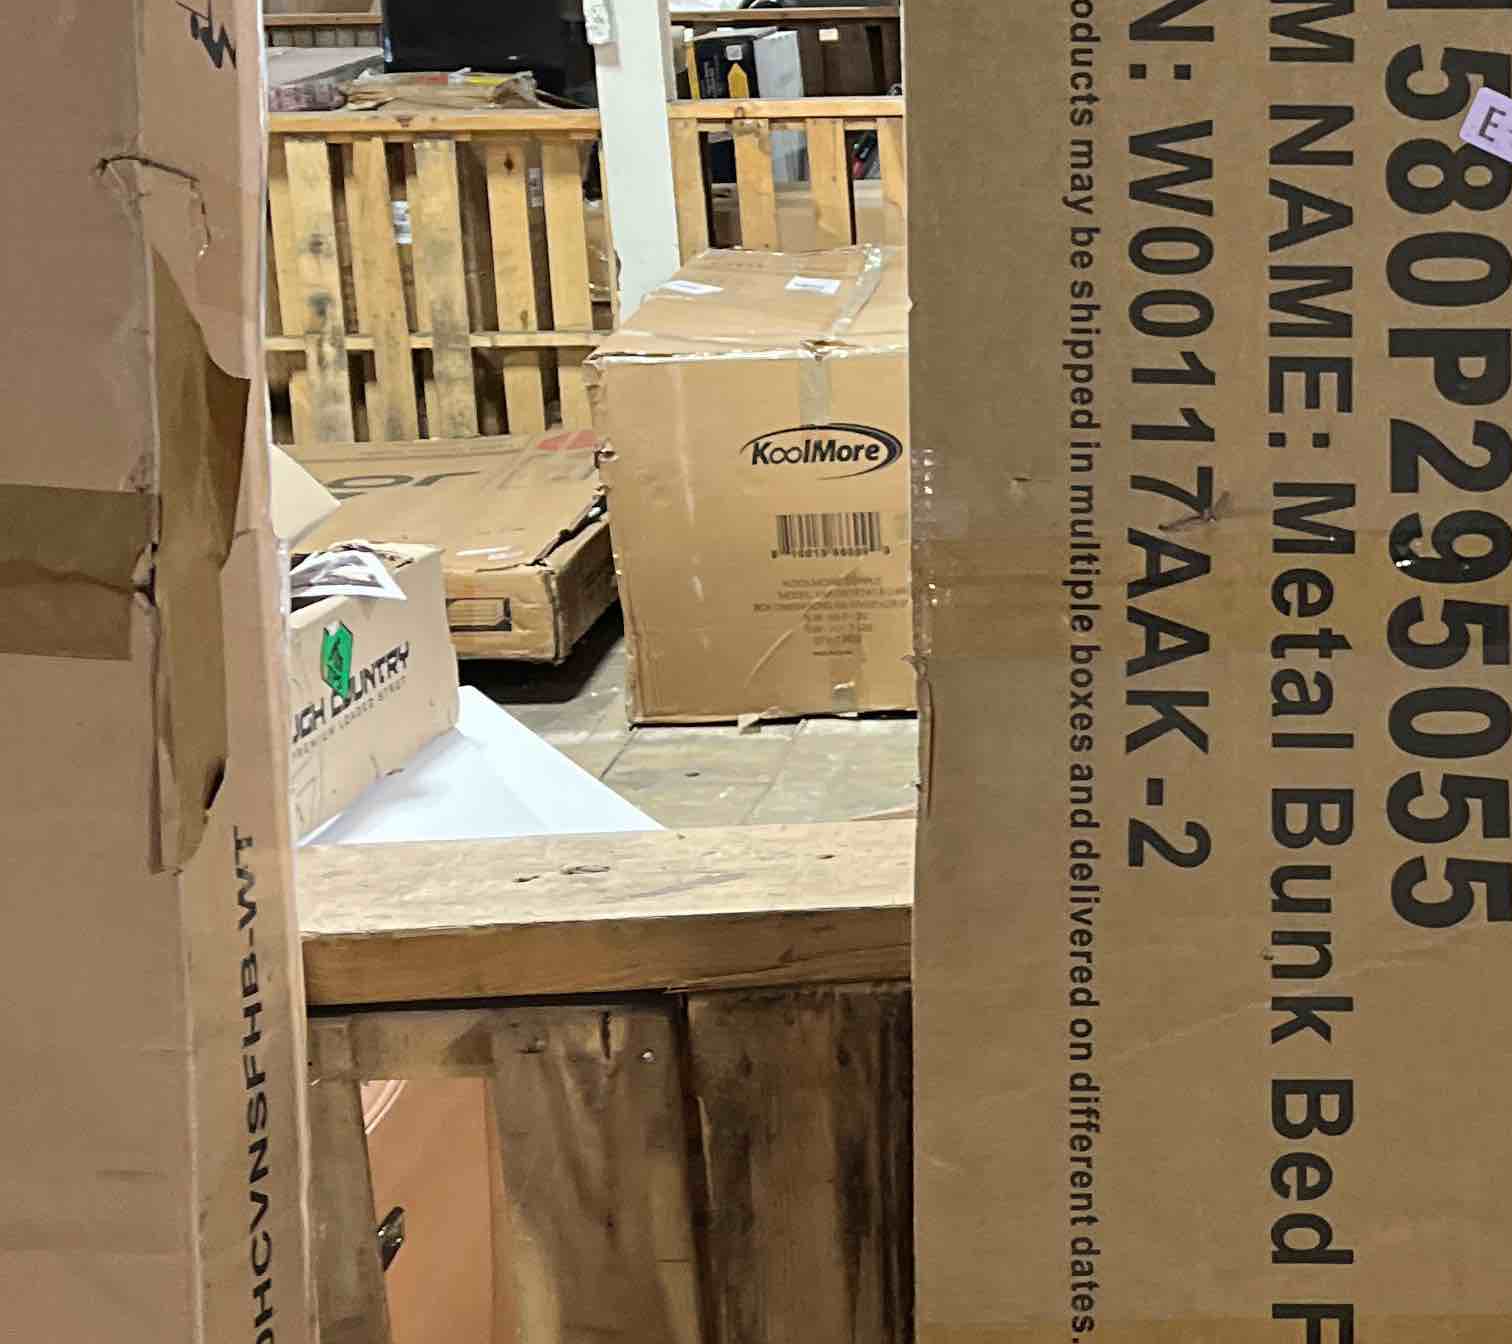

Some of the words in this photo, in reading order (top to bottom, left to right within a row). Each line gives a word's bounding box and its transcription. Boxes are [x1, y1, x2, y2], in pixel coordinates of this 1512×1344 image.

[1060, 138, 1096, 215] may
[1069, 226, 1102, 269] be
[1267, 103, 1353, 449] NAME:
[1060, 279, 1102, 429] shipped
[751, 438, 881, 465] KoolMore
[1068, 441, 1102, 472] in
[1124, 120, 1215, 869] W00117AAK-2
[1060, 484, 1104, 632] multiple
[1269, 482, 1355, 749] Metal
[1068, 644, 1104, 752] boxes
[1068, 763, 1100, 828] and
[1067, 839, 1103, 1006] delivered
[1268, 788, 1353, 1046] Bunk
[1068, 1018, 1093, 1060] on
[1068, 1071, 1104, 1226] different
[1268, 1079, 1353, 1265] Bed
[1069, 1236, 1101, 1344] dates.
